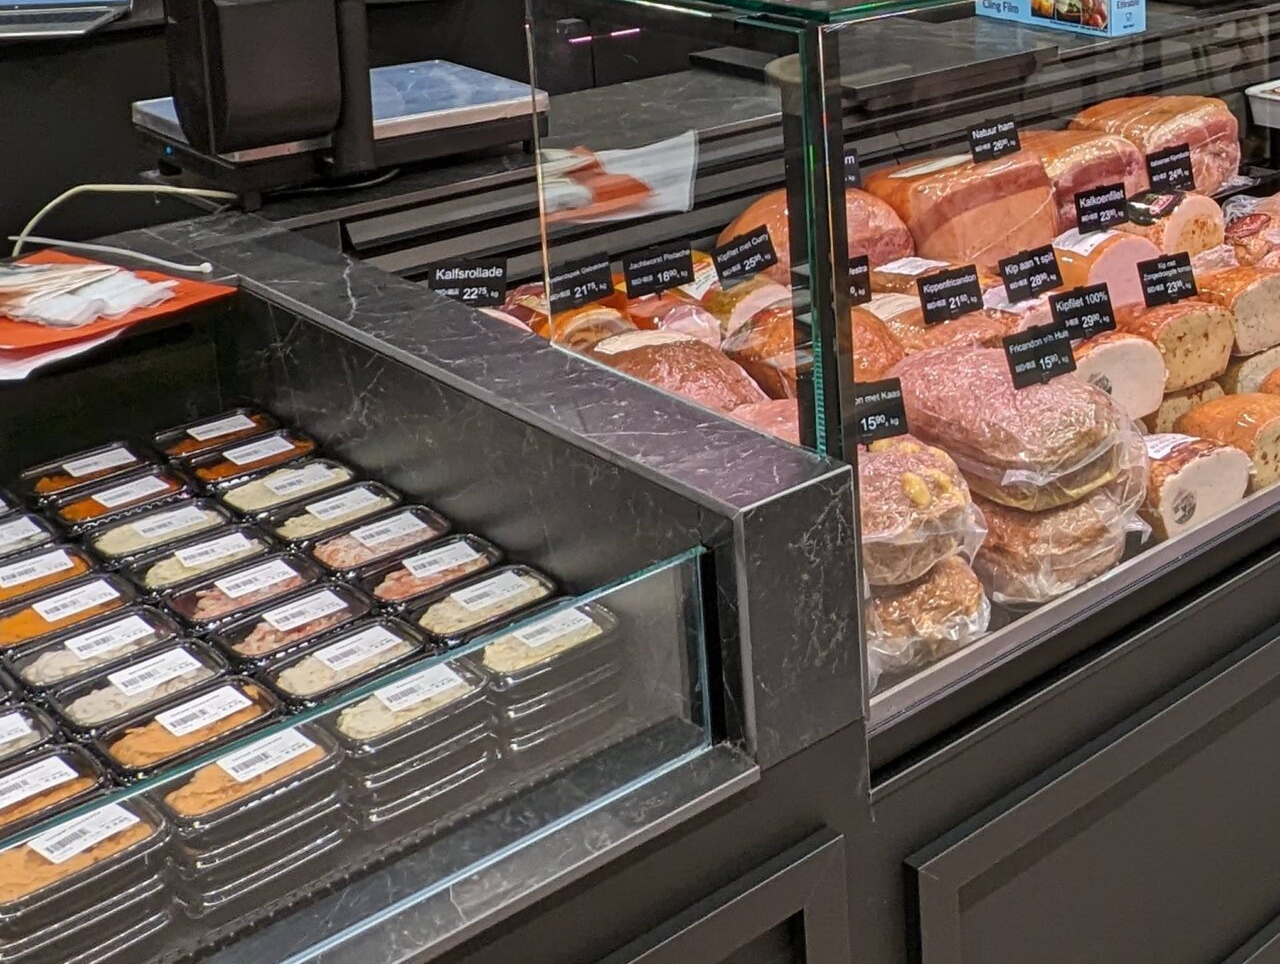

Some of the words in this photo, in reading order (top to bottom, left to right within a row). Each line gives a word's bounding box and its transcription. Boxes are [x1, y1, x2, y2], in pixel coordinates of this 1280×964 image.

[972, 126, 997, 140] Natuur
[997, 121, 1015, 132] ham
[1079, 189, 1124, 209] Kalkoenfilet
[435, 266, 503, 280] Kalfsrollade
[1004, 264, 1019, 275] Kip
[1019, 259, 1034, 271] aan
[1055, 298, 1085, 312] Kipfilet
[1085, 291, 1108, 305] 100%
[1008, 337, 1043, 354] Fricandon
[864, 393, 881, 403] met
[880, 388, 901, 400] Kaas
